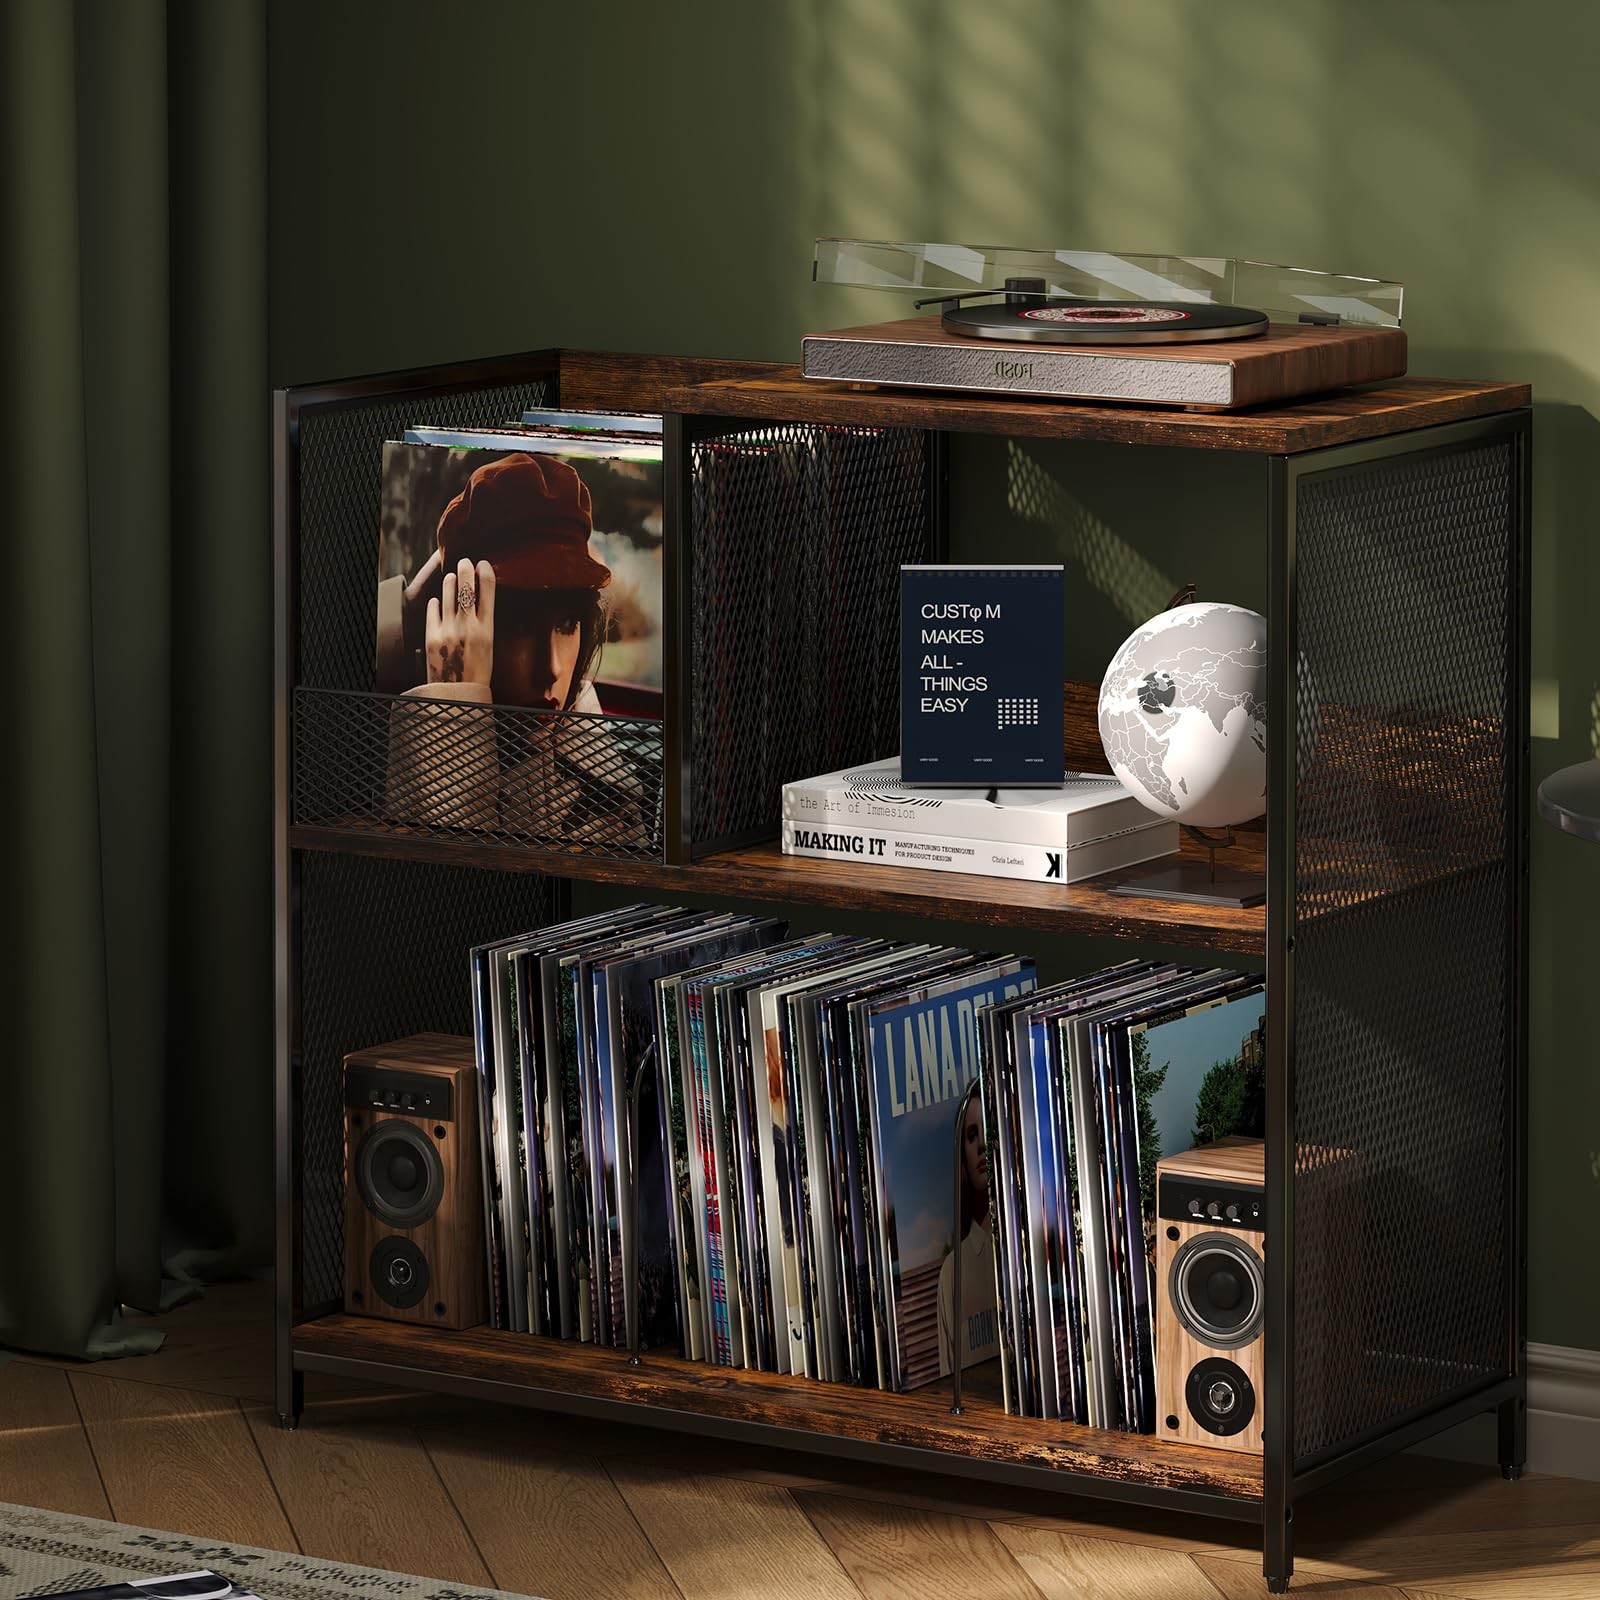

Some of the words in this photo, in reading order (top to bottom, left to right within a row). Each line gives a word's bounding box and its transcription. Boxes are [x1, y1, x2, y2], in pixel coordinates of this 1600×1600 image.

[921, 629, 985, 645] MAKES
[920, 654, 953, 670] ALL
[920, 676, 988, 692] THINGS
[921, 697, 969, 713] EASY
[800, 796, 818, 809] the
[823, 799, 842, 812] Art
[848, 802, 860, 813] of
[867, 803, 916, 819] Immesion
[794, 830, 864, 854] MAKING
[869, 838, 887, 856] IT
[895, 841, 941, 852] MANUFACTURING
[942, 846, 975, 856] TECHNIQUES
[907, 852, 931, 861] PRODUCT
[932, 855, 952, 863] DESIGN
[992, 855, 1006, 864] Chris
[884, 1005, 960, 1118] LANA
